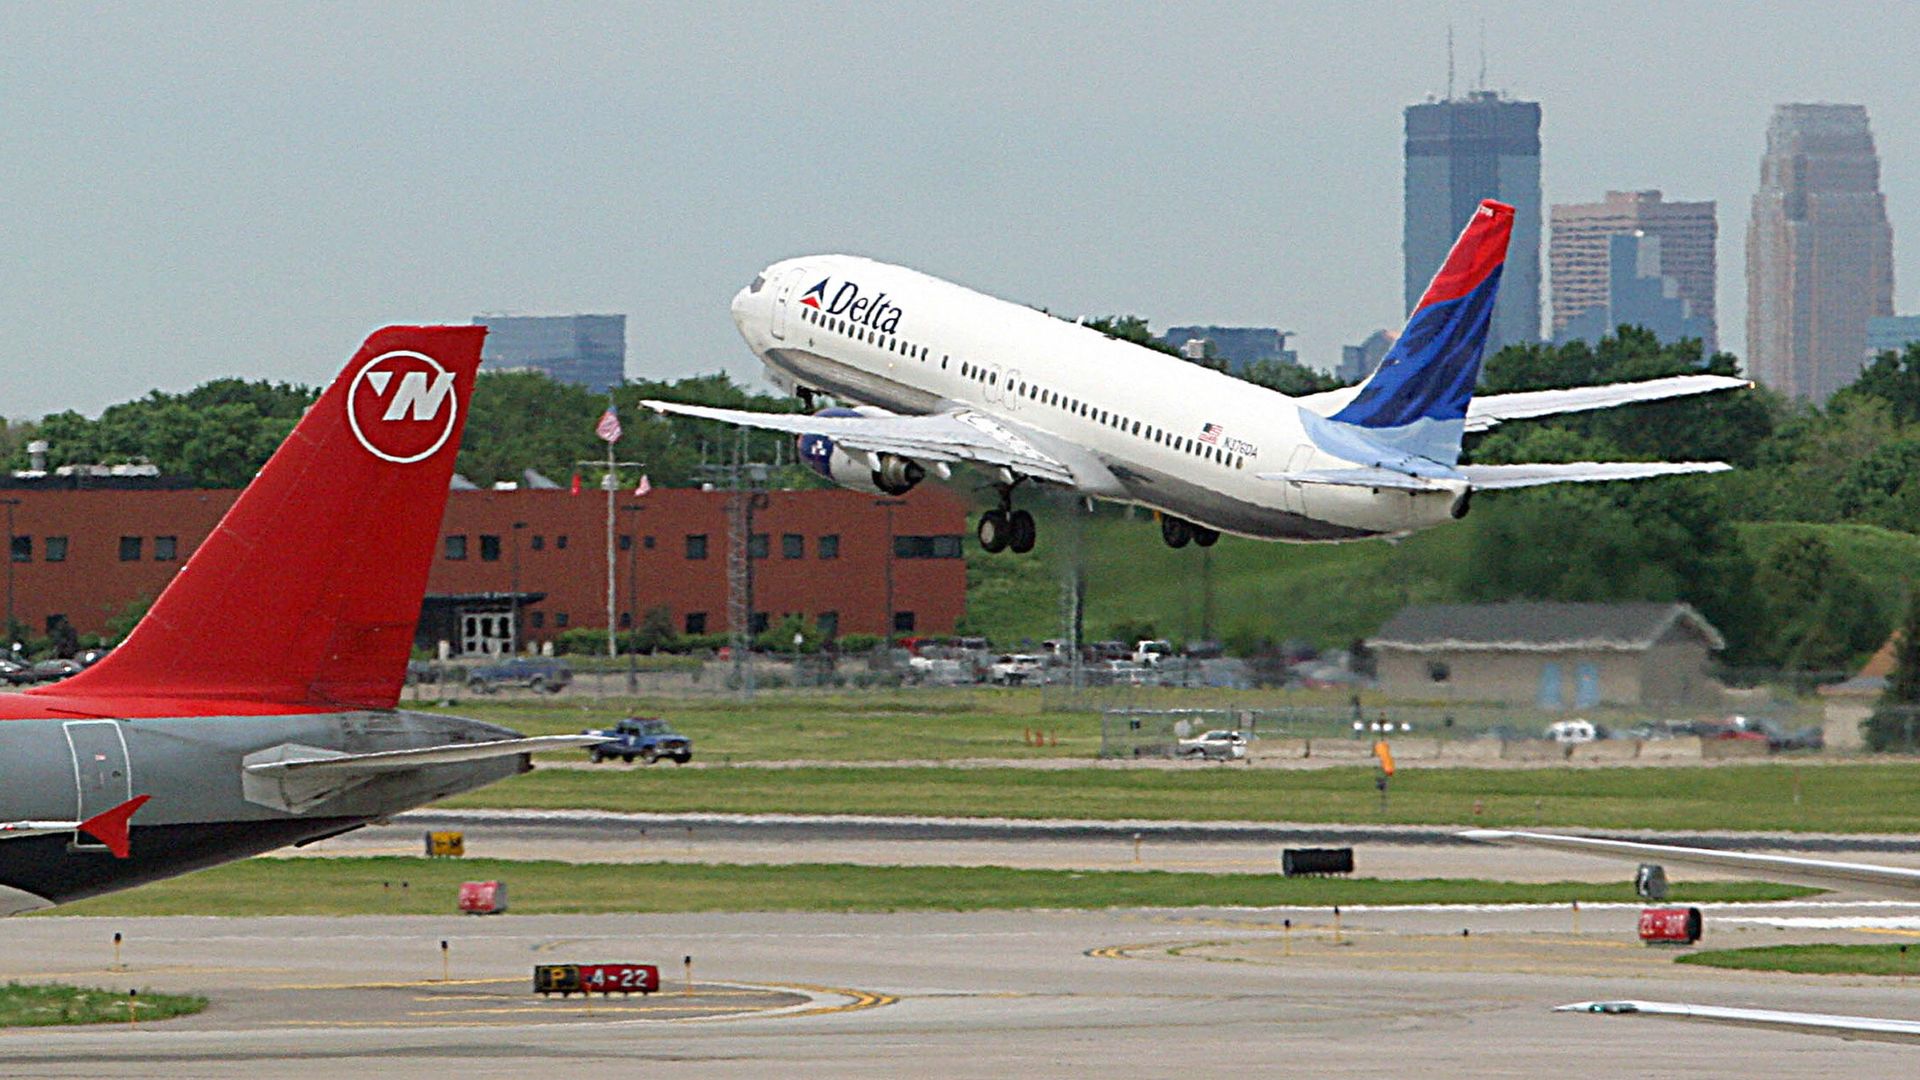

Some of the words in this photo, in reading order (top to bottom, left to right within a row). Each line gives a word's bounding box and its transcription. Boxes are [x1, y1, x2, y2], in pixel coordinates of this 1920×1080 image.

[825, 281, 903, 335] Delta
[551, 966, 566, 989] P
[592, 968, 649, 987] 4-22
